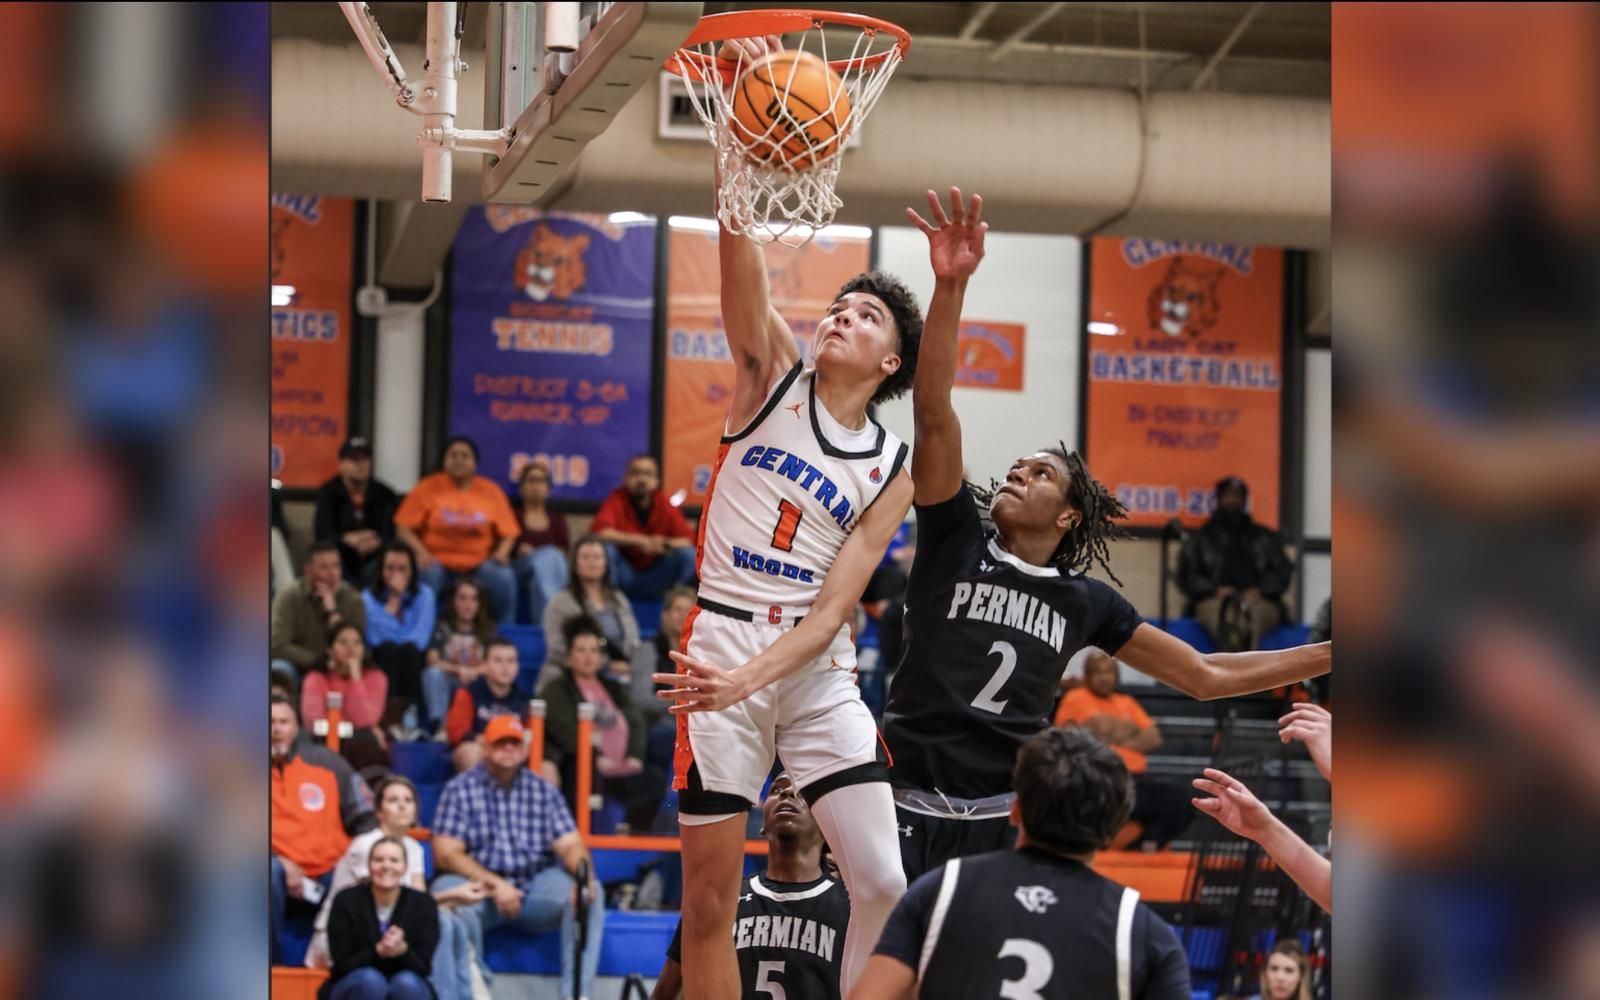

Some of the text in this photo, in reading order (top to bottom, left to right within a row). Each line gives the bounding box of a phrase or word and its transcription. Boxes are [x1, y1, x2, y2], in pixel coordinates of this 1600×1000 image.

[492, 317, 613, 357] TENNIS
[1090, 352, 1282, 391] BASKETBALL
[771, 498, 802, 552] 1
[768, 605, 782, 624] C
[947, 582, 1067, 654] PERMIAN
[970, 640, 1017, 715] 2
[754, 961, 787, 1000] 5
[997, 938, 1054, 1000] 3
